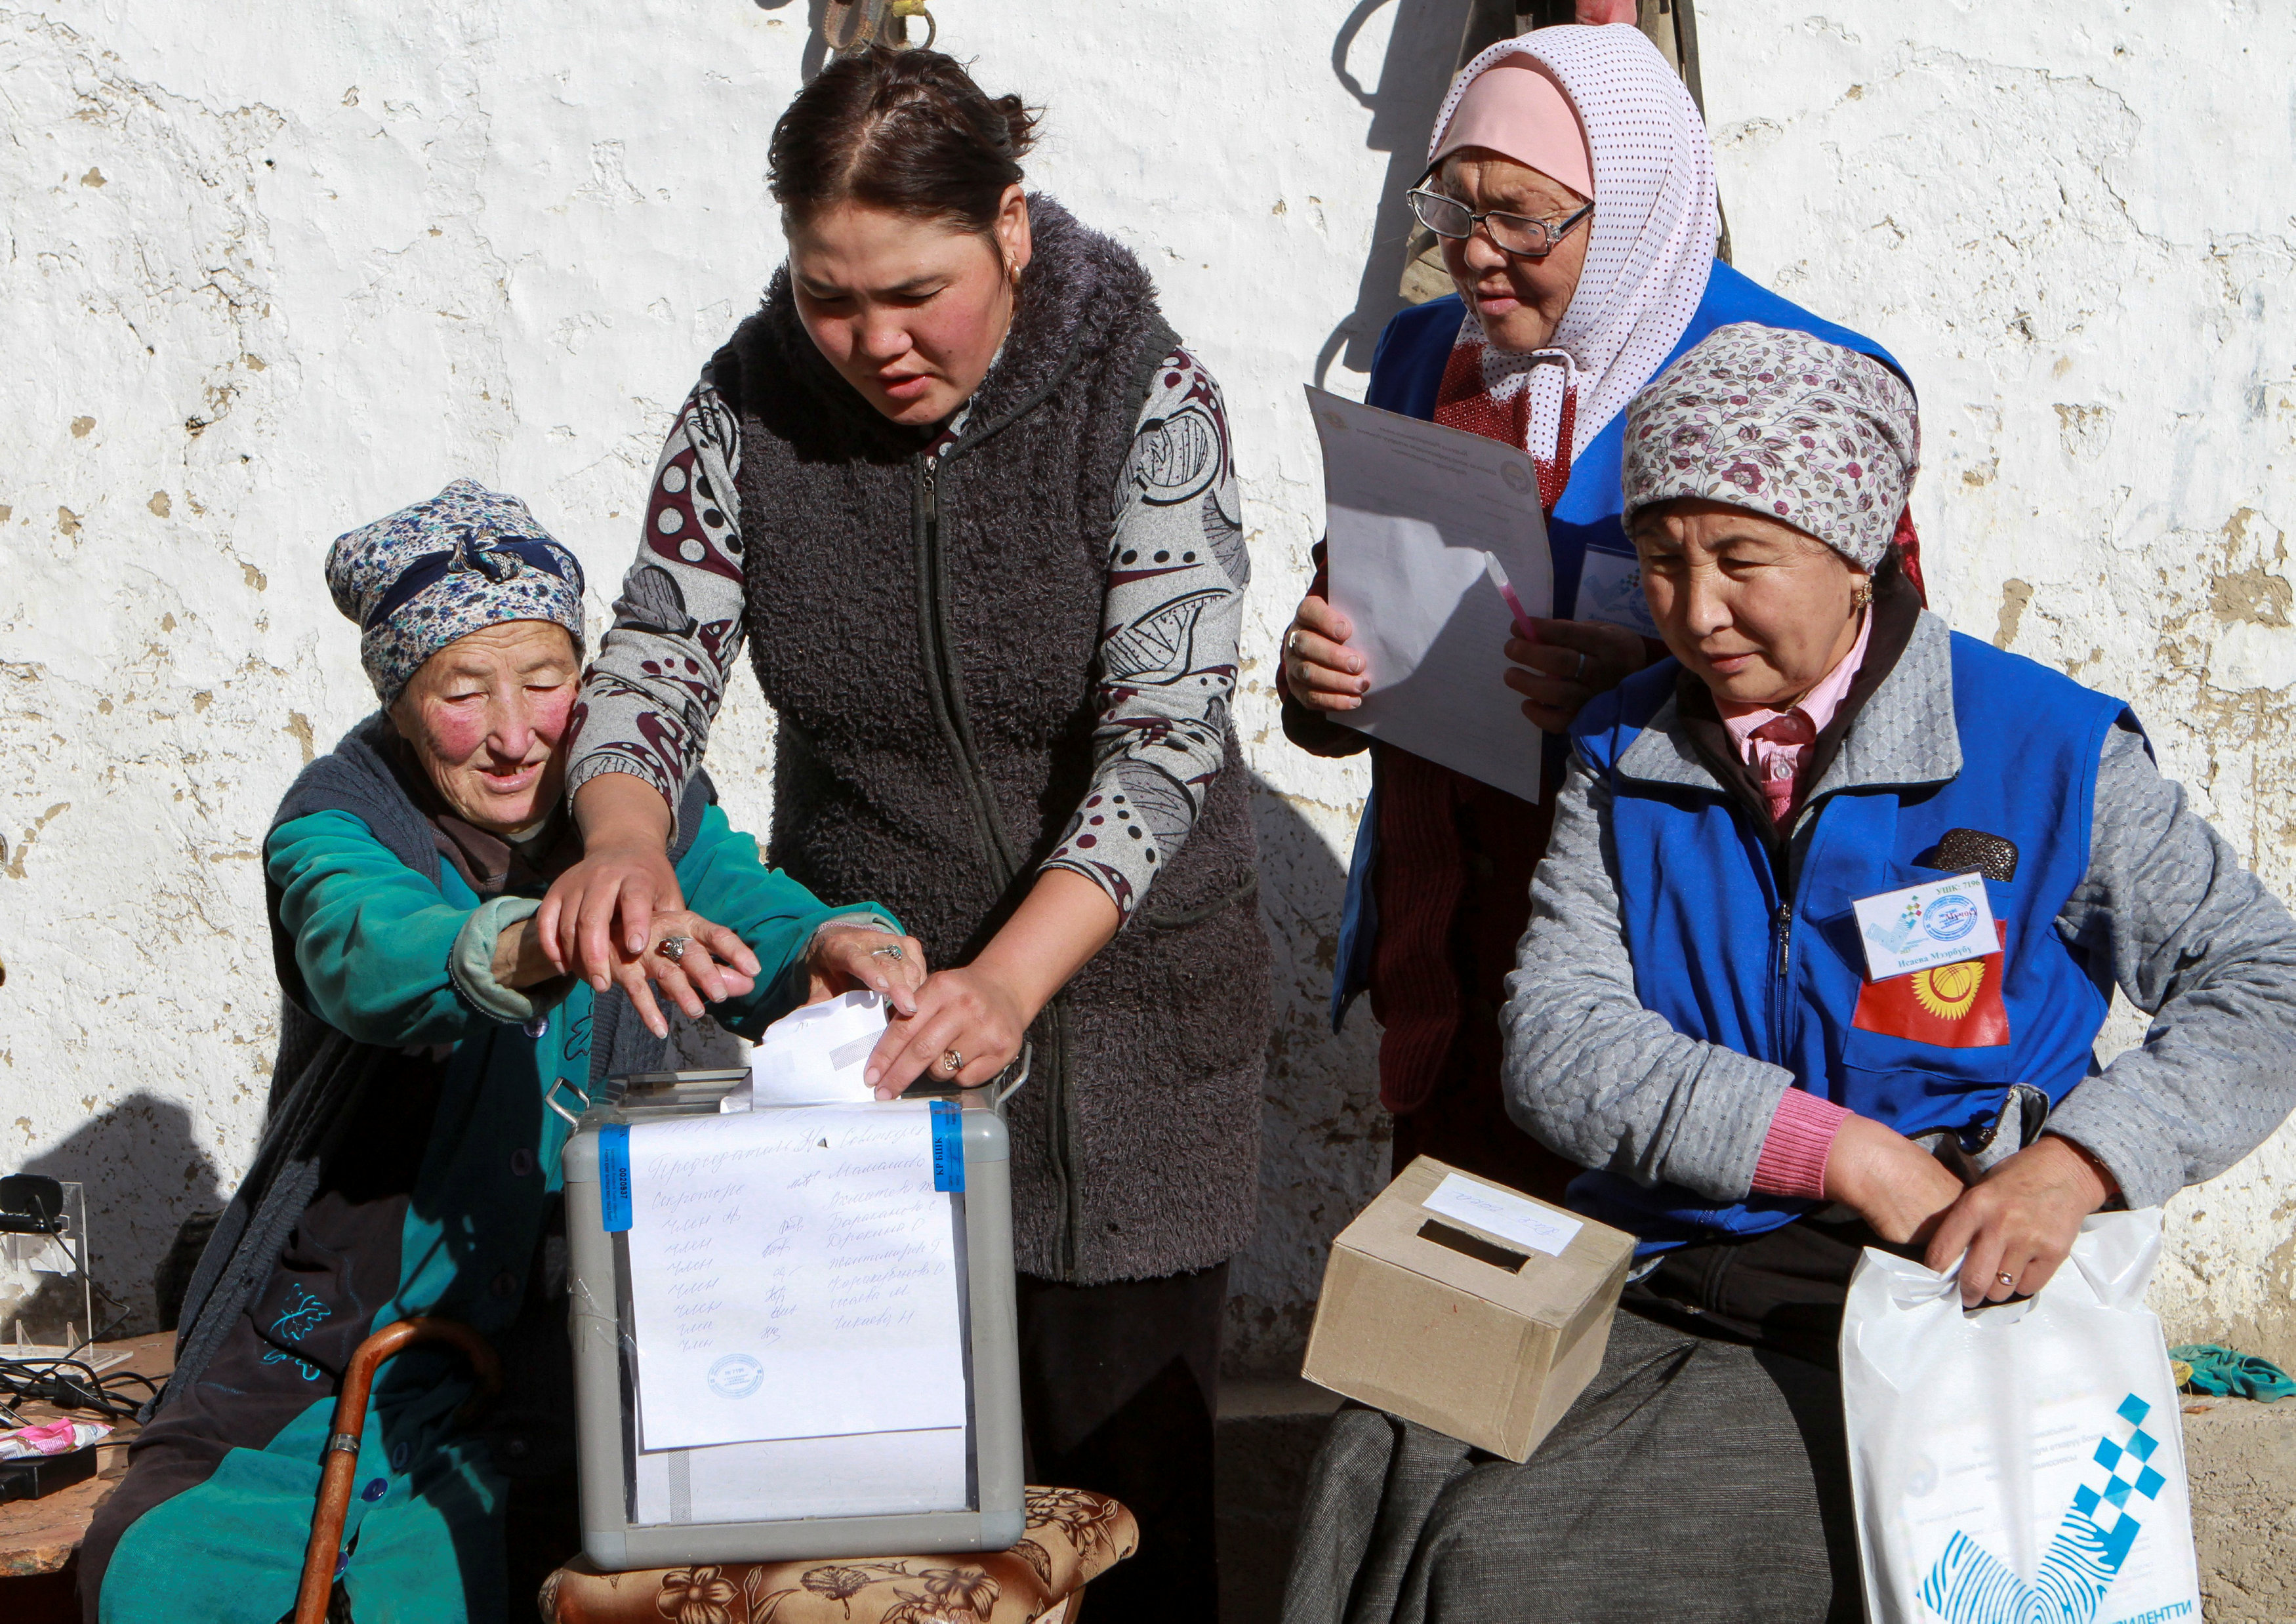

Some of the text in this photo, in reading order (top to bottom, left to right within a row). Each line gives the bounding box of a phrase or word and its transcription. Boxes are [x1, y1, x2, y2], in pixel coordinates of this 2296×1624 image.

[1963, 879, 1981, 890] 7196
[1898, 956, 1929, 968] Исаева
[934, 1136, 944, 1176] КР БШК
